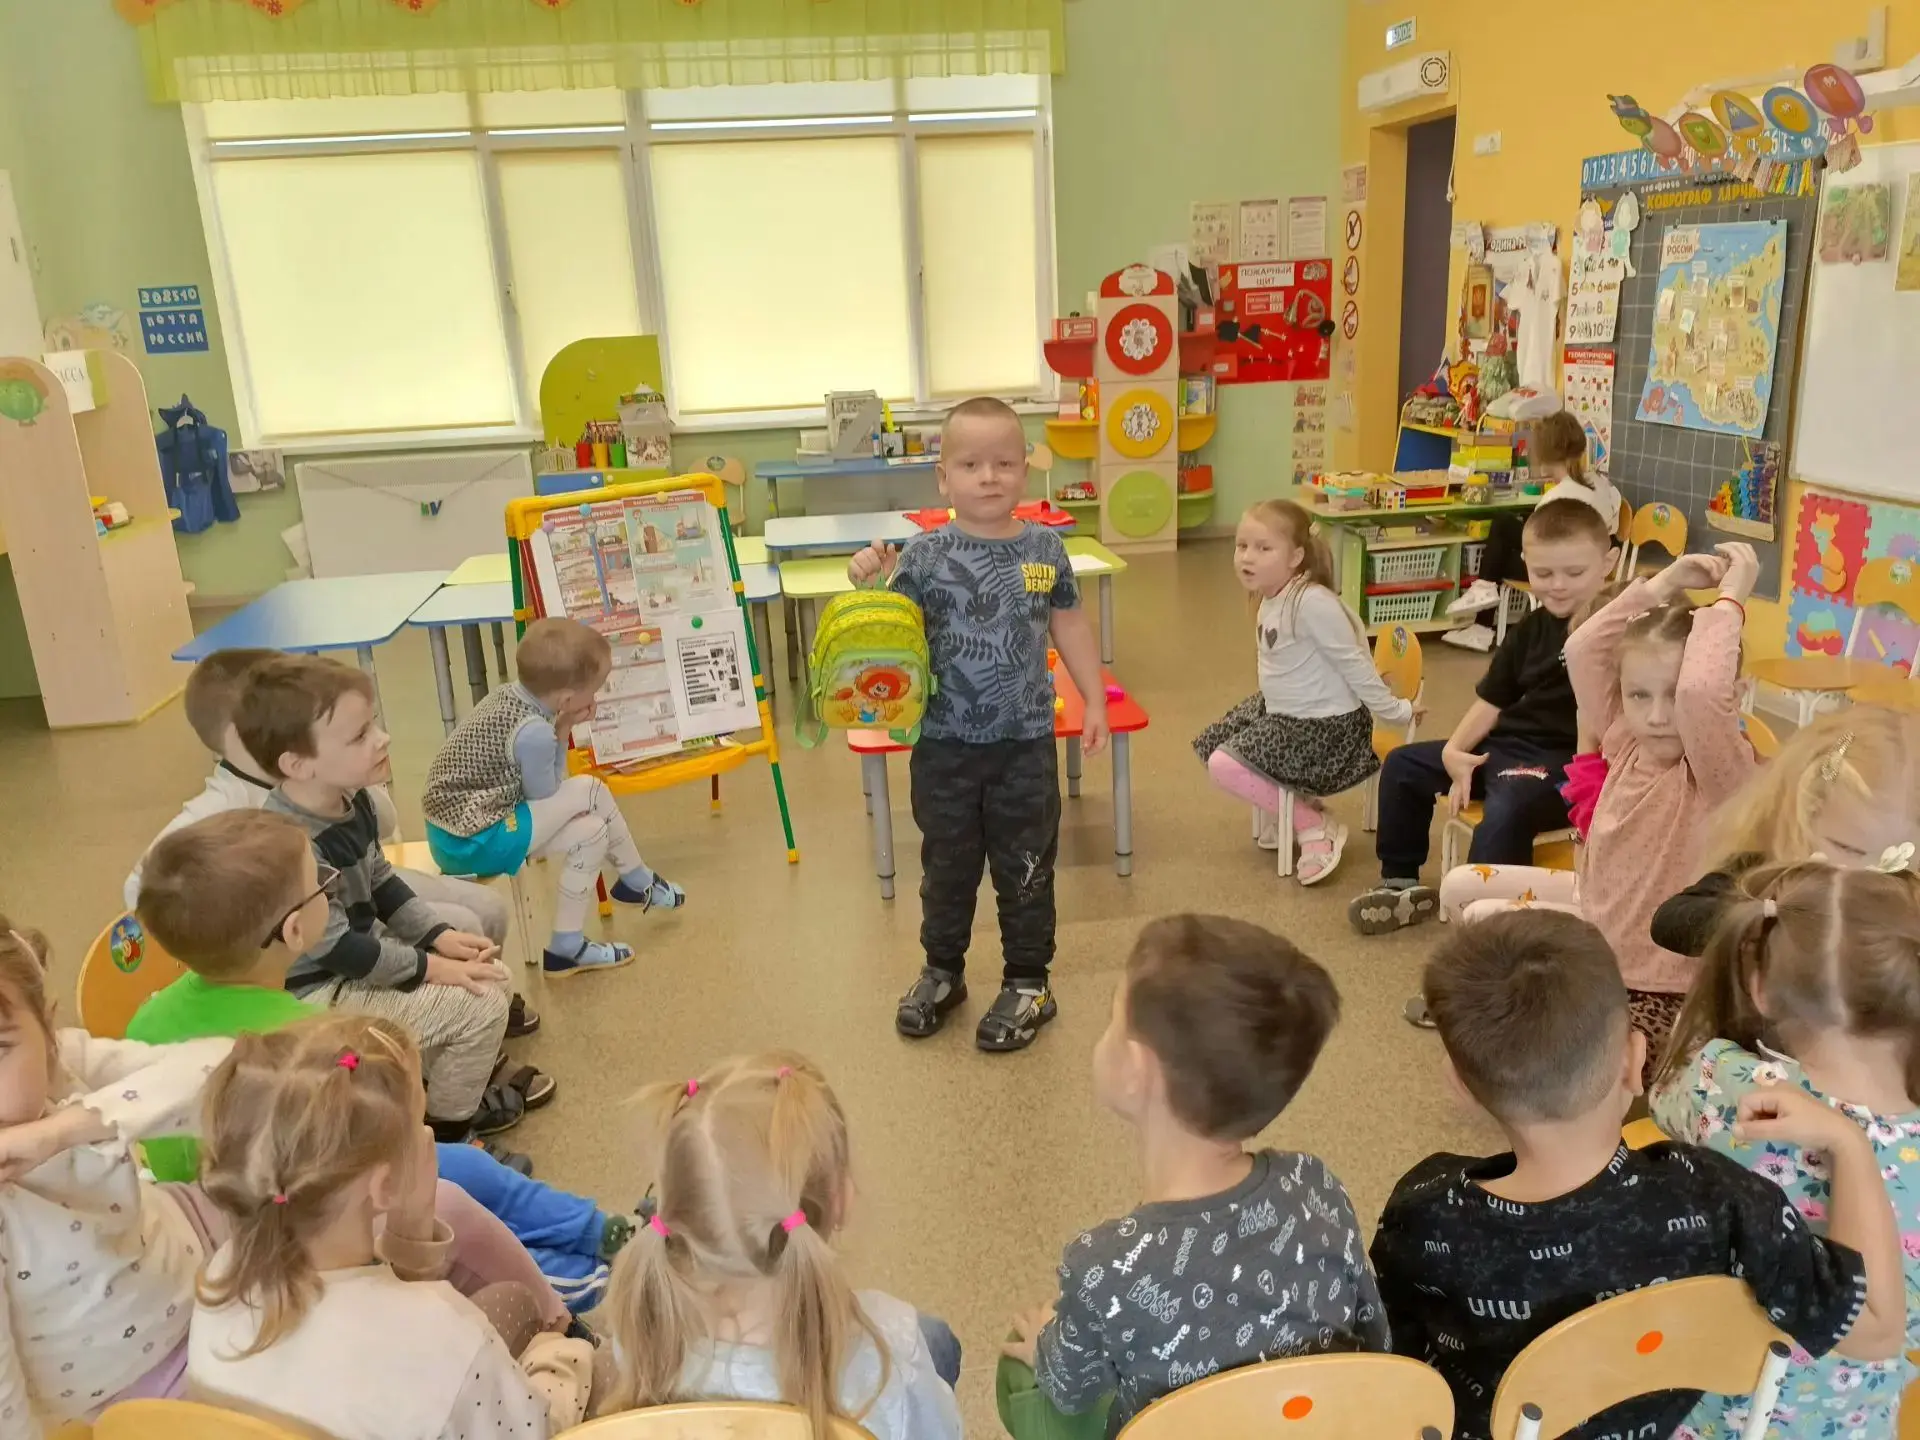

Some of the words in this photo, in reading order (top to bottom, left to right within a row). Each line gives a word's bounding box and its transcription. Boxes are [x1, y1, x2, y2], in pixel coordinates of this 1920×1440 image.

[1583, 162, 1589, 183] 0
[1592, 160, 1598, 182] 1
[1600, 159, 1607, 181] 2
[1609, 158, 1616, 180] 3
[1620, 156, 1627, 177] 4
[1631, 153, 1638, 176] 5
[1641, 151, 1648, 175] 6
[1647, 186, 1713, 211] КОВРОГРАФ
[1666, 244, 1694, 256] РОССИИ
[1240, 266, 1292, 277] ПОЖАРНЫЙ
[1598, 258, 1605, 272] 4
[1256, 277, 1275, 286] ЩИТ
[1571, 282, 1579, 297] 5
[1597, 280, 1603, 294] 6
[141, 288, 197, 305] 308510
[1570, 303, 1578, 318] 7
[1596, 301, 1603, 315] 8
[146, 313, 198, 328] ПОЧТА
[149, 331, 204, 345] РОССИИ
[1569, 324, 1577, 338] 9
[1593, 323, 1604, 337] 10
[1021, 562, 1056, 580] SOUTH
[1025, 577, 1056, 593] BEACH
[1667, 1214, 1707, 1233] min
[1424, 1240, 1451, 1254] min
[1529, 1242, 1573, 1261] min
[1126, 1273, 1182, 1324] BOSS
[1467, 1296, 1533, 1321] min
